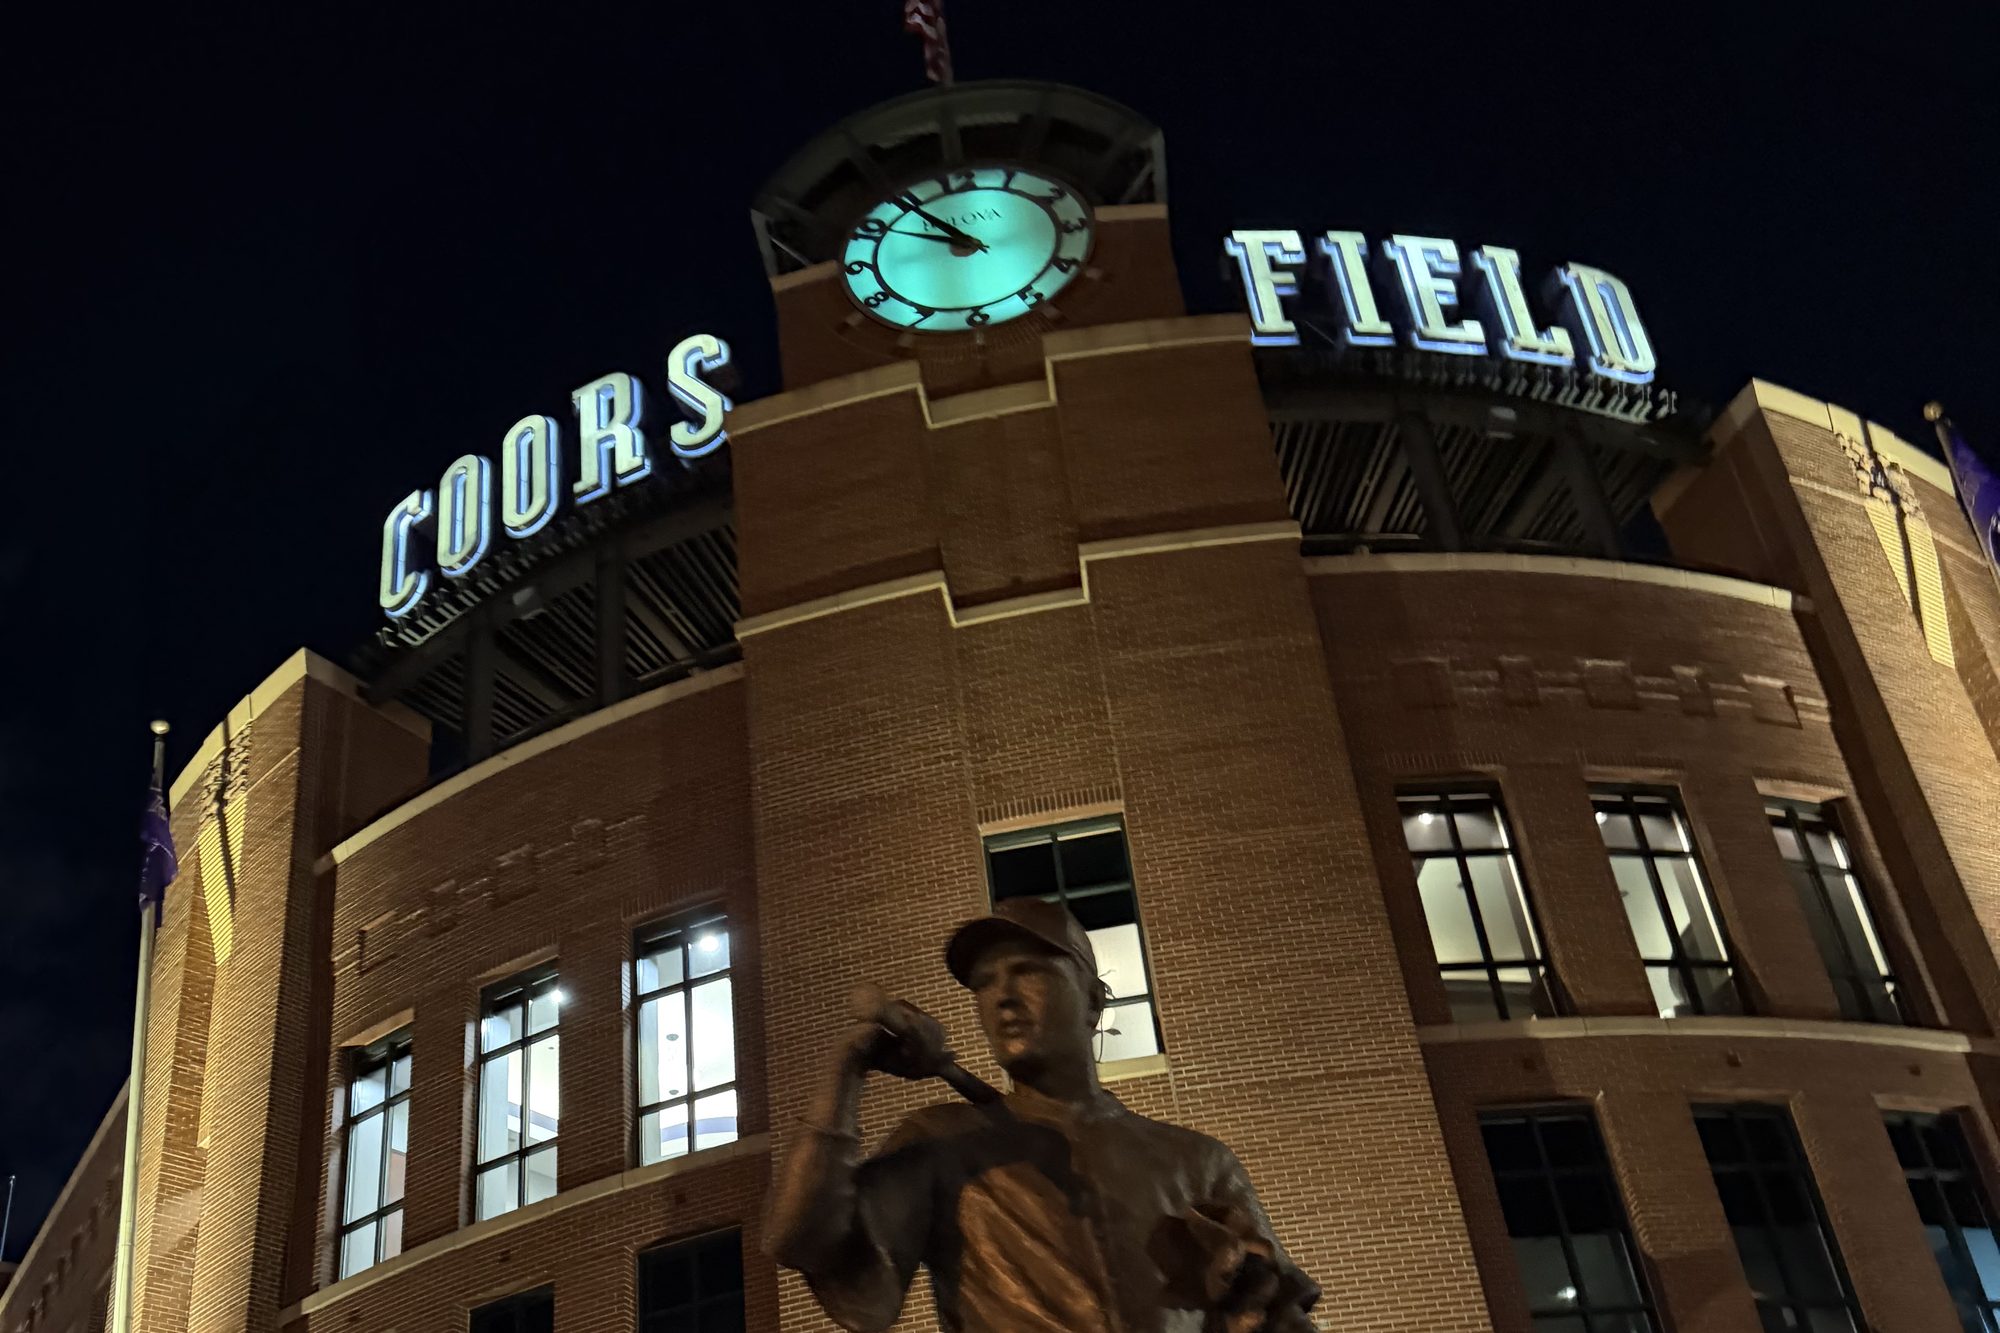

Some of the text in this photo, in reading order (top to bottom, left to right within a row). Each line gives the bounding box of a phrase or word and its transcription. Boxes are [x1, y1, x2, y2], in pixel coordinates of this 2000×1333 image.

[843, 260, 876, 276] 9
[864, 291, 890, 308] 8
[1224, 230, 1657, 384] FIELD
[379, 333, 733, 618] COORS
